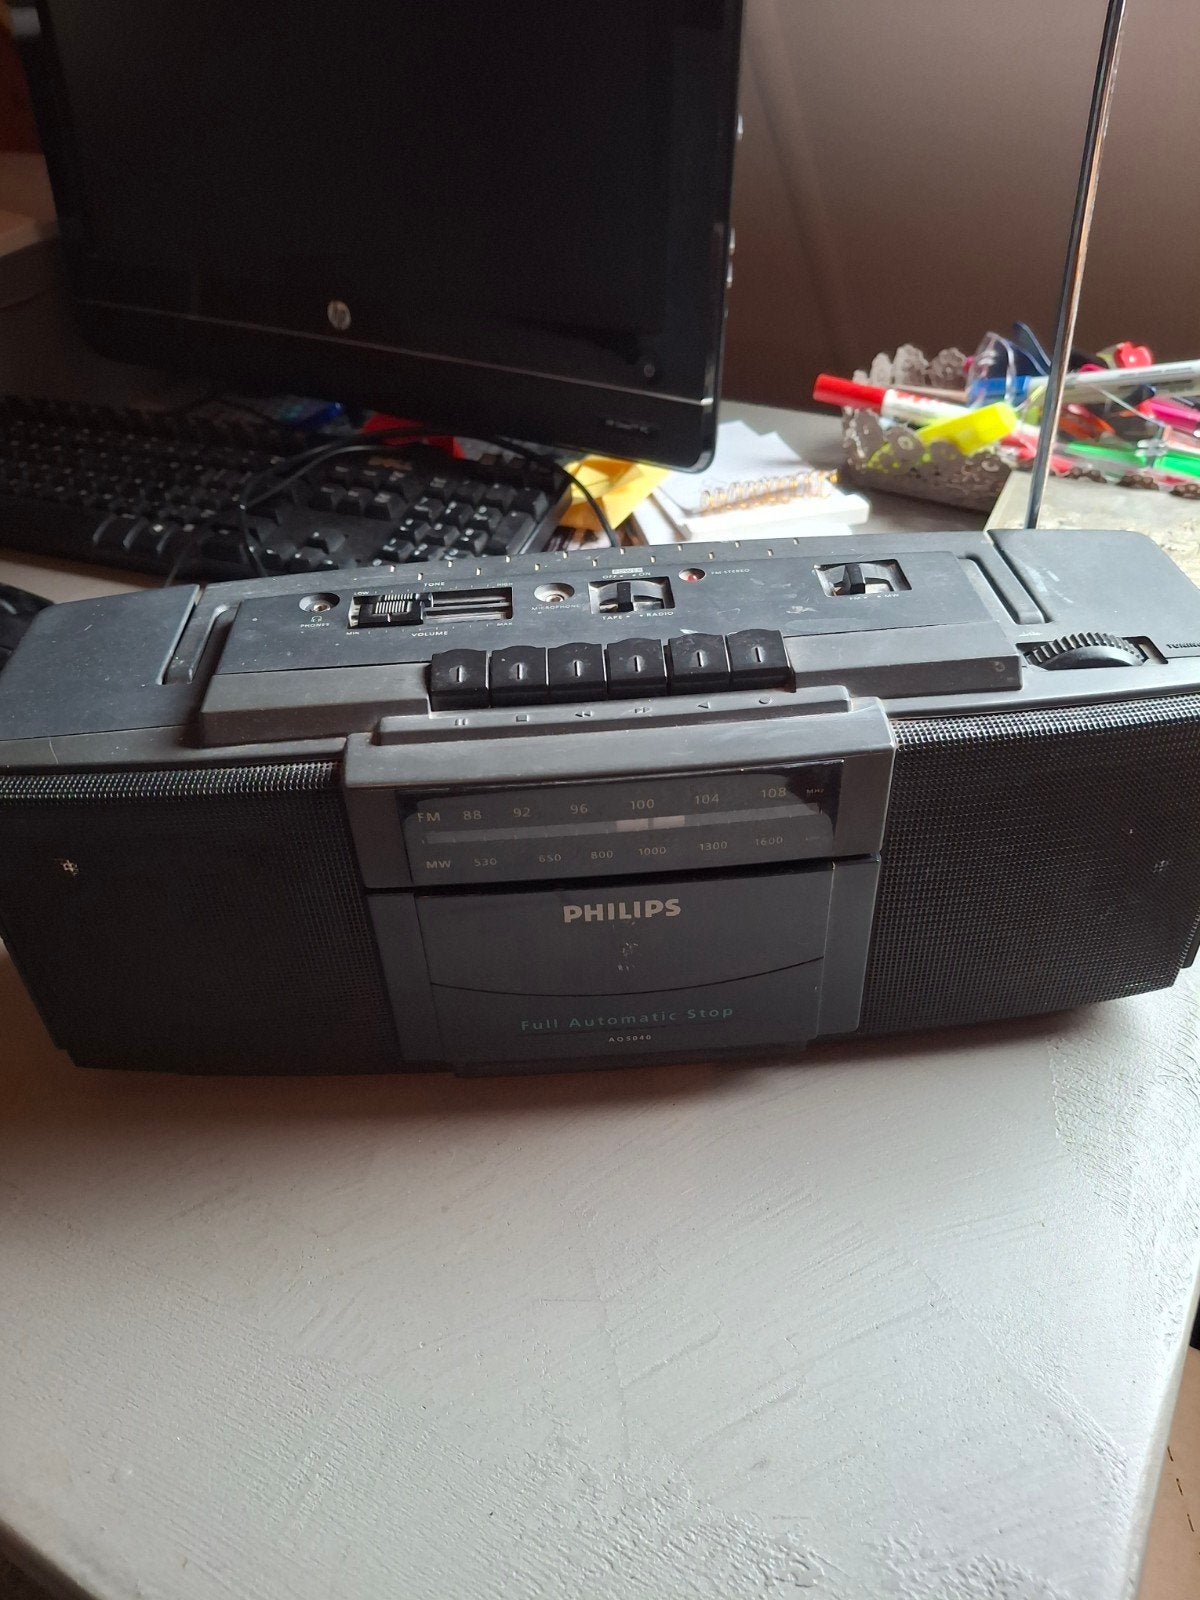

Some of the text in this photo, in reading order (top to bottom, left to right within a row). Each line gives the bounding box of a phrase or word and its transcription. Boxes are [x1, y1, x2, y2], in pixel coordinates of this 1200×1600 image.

[417, 811, 441, 823] FM
[463, 810, 482, 821] 88
[513, 807, 531, 818] 92
[570, 803, 588, 815] 96
[630, 798, 655, 811] 100
[695, 793, 720, 805] 104
[761, 787, 787, 799] 108
[426, 836, 783, 870] MW 530 650 800 1000 1300 1600
[563, 898, 682, 924] PHILIPS
[521, 1007, 734, 1031] Full Automatic Stop
